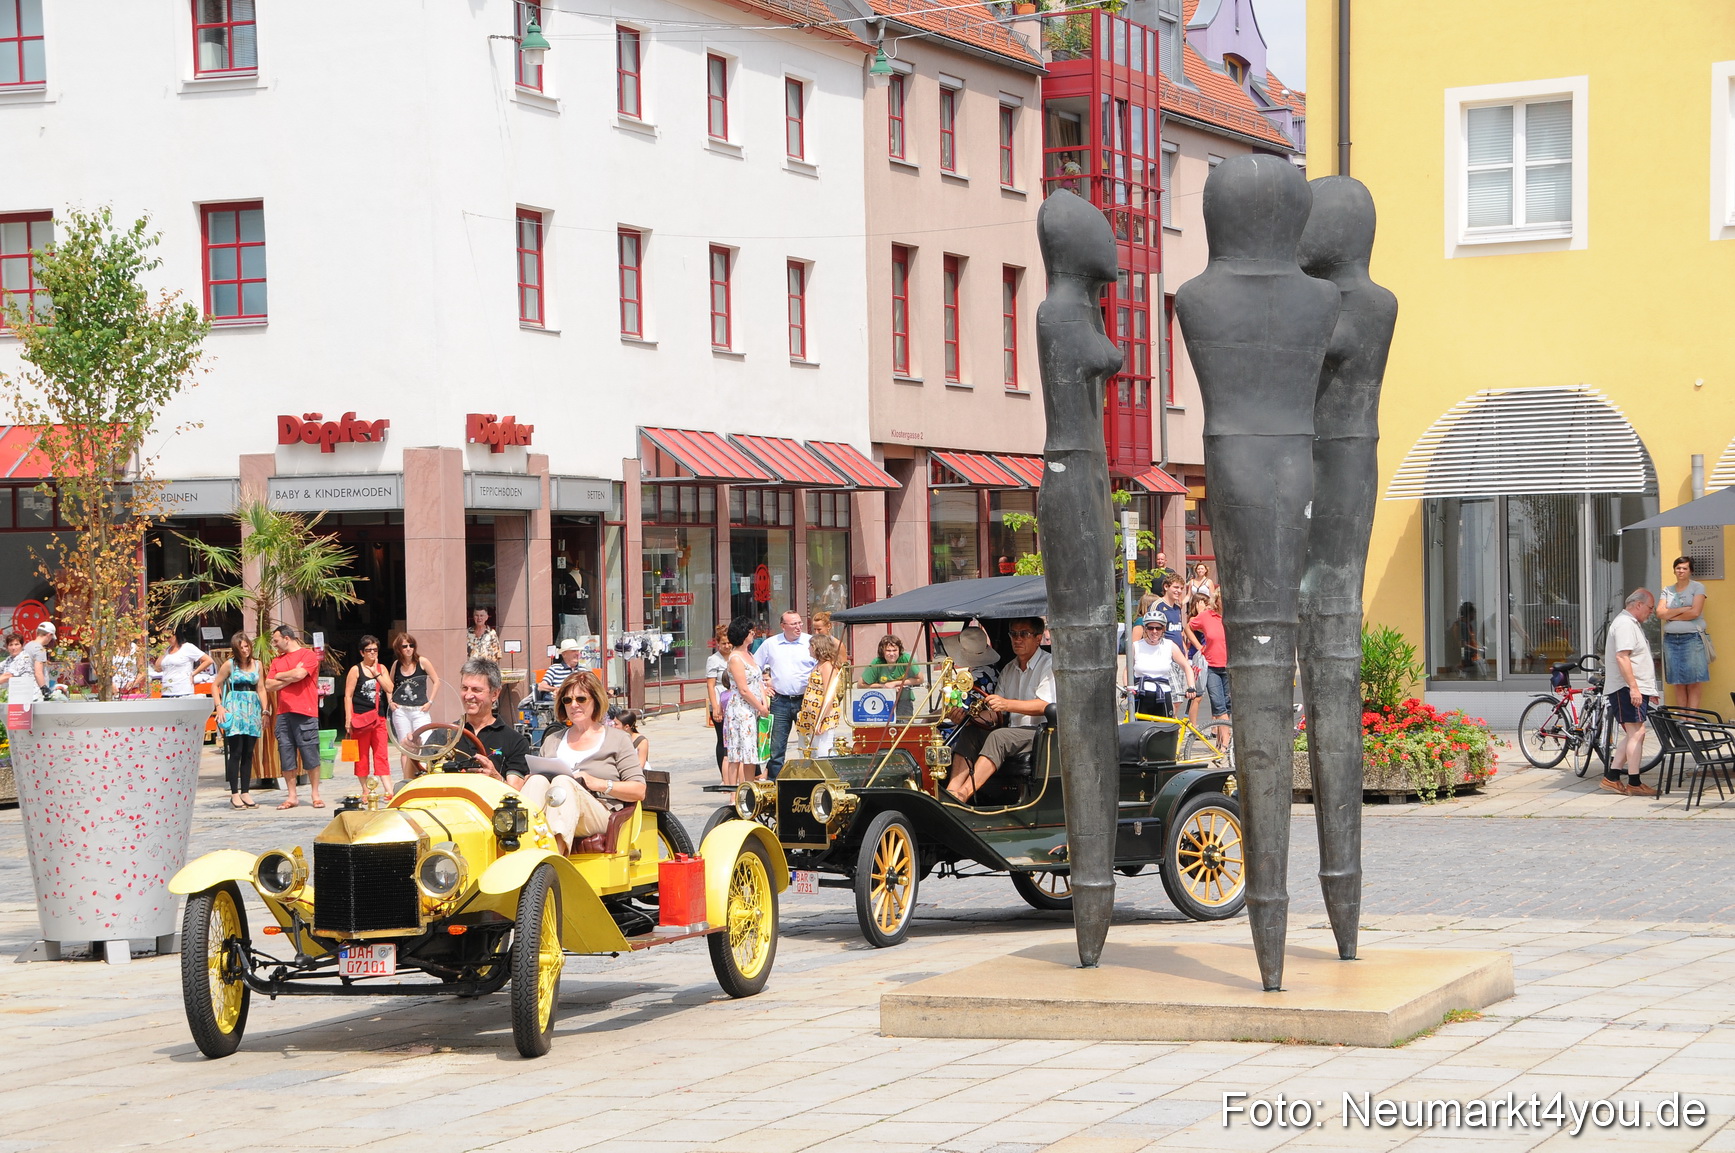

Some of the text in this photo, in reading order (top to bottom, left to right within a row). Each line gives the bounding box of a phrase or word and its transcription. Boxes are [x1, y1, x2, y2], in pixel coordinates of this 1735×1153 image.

[277, 411, 390, 453] Döpfer
[466, 413, 534, 453] Döpfer
[890, 429, 919, 440] Klostergasse
[145, 492, 198, 503] GRDINEN
[275, 486, 393, 500] BABY & KINDERMODEN
[479, 486, 523, 497] TEPPICHBODEN
[587, 490, 605, 500] BETTEN
[871, 700, 876, 710] 2
[791, 796, 811, 813] Ford
[346, 960, 387, 974] 07101
